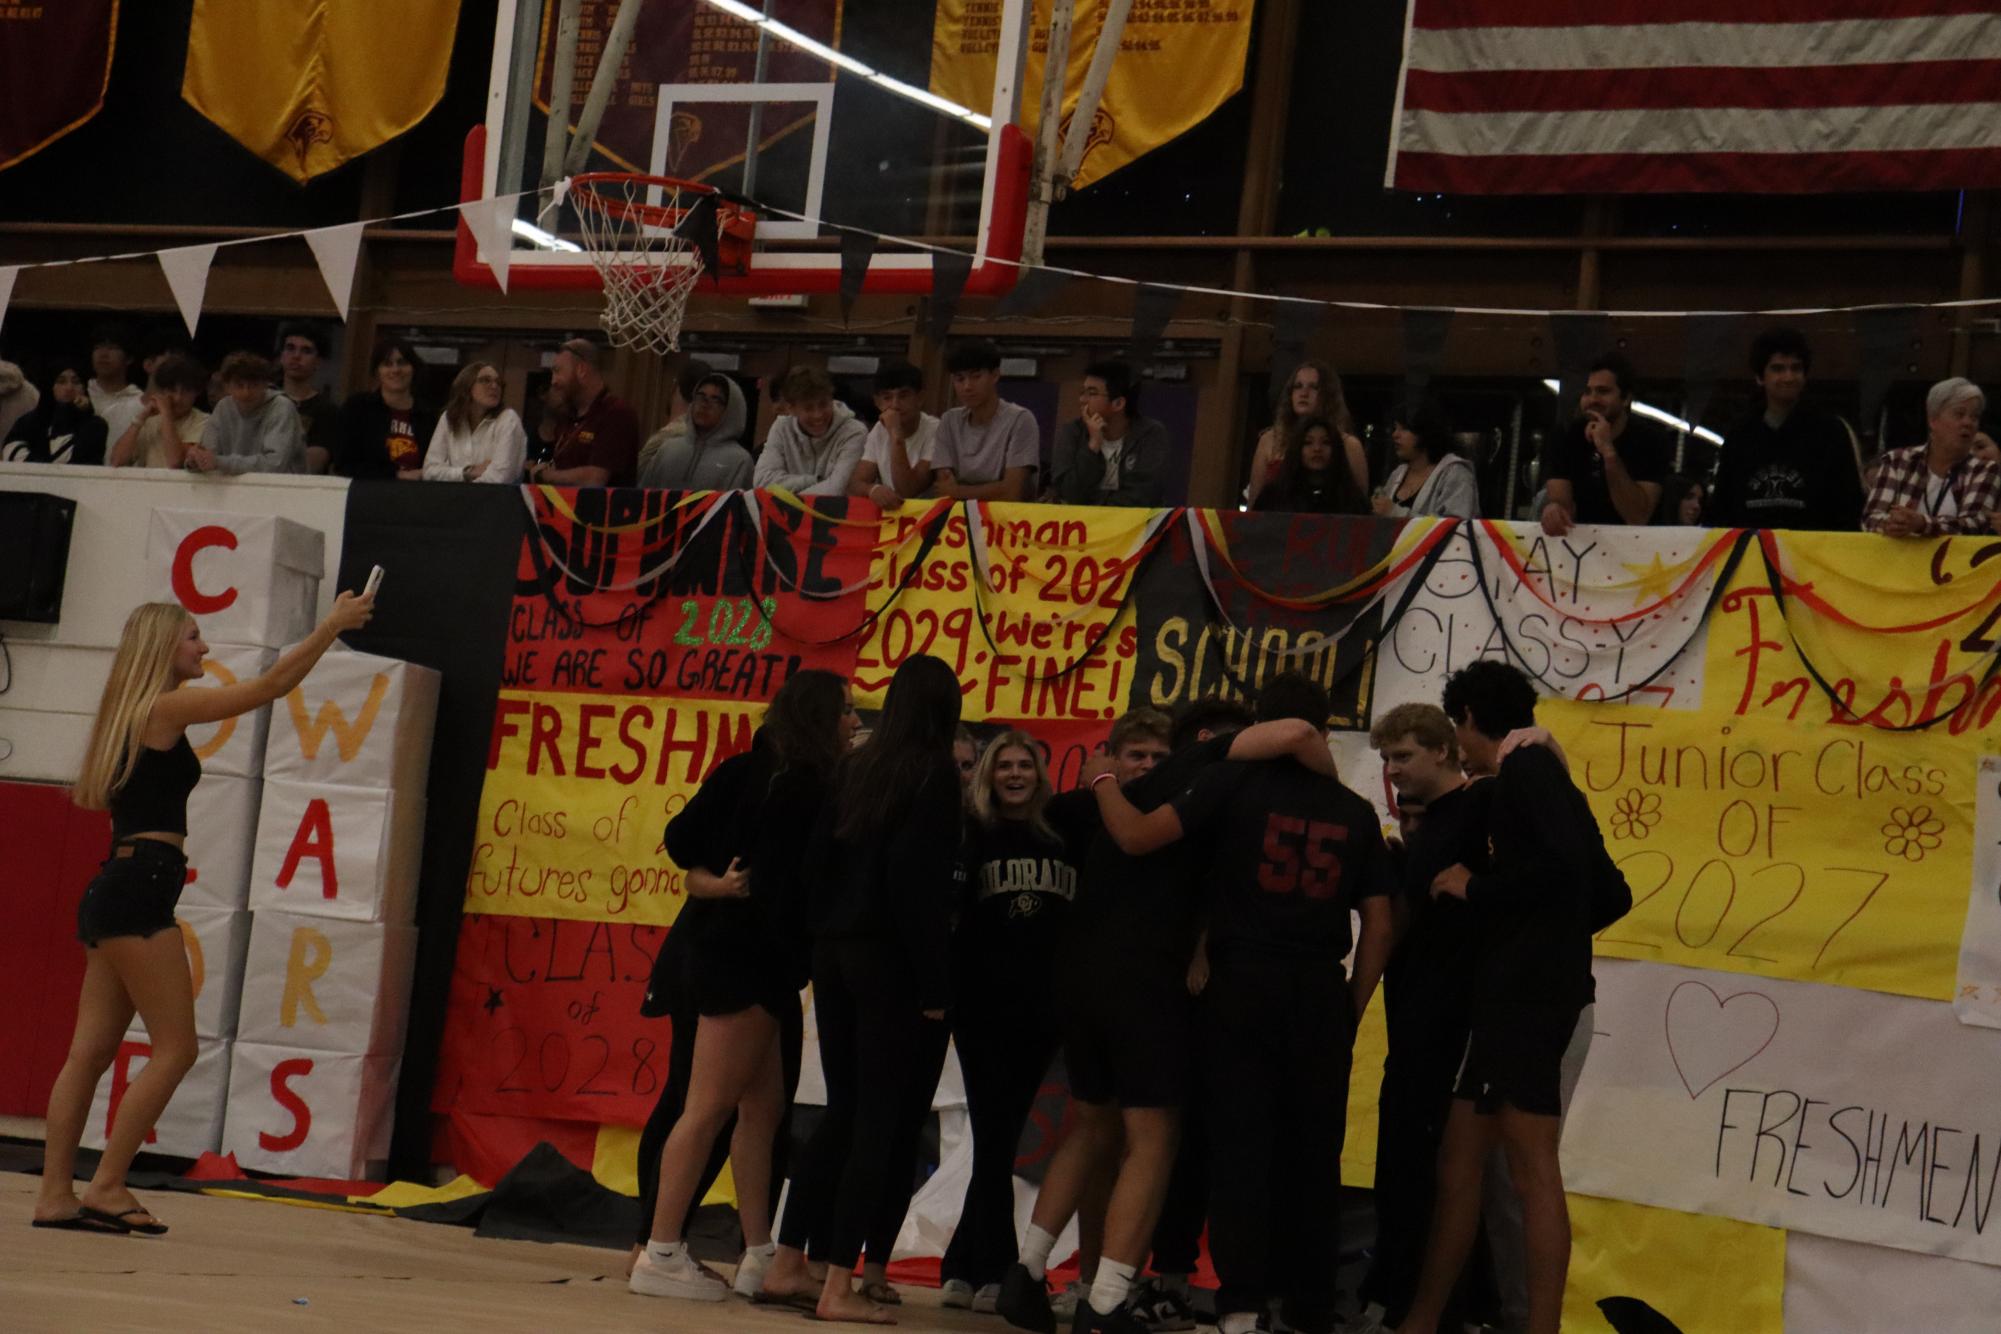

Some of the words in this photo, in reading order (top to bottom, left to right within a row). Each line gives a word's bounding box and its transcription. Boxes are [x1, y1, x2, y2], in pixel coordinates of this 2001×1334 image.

[867, 550, 969, 593] Class
[988, 554, 1029, 594] of
[1424, 530, 1598, 605] SAY
[512, 601, 584, 643] CLASS
[616, 601, 655, 643] OF
[673, 596, 778, 651] 2028
[500, 650, 537, 687] WE
[553, 649, 607, 688] ARE
[623, 649, 668, 690] SO
[985, 654, 1122, 719] FINE!
[1584, 720, 1800, 792] Junior
[1814, 738, 1949, 798] Class
[493, 799, 567, 838] Class
[592, 795, 639, 843] of
[1717, 799, 1804, 859] OF
[466, 842, 592, 903] futures
[606, 864, 681, 915] gonna
[1256, 812, 1350, 900] 55
[1594, 849, 1890, 970] 2027
[567, 990, 603, 1025] of
[491, 1026, 657, 1096] 2028
[1715, 1088, 2001, 1235] FRESHMEN
